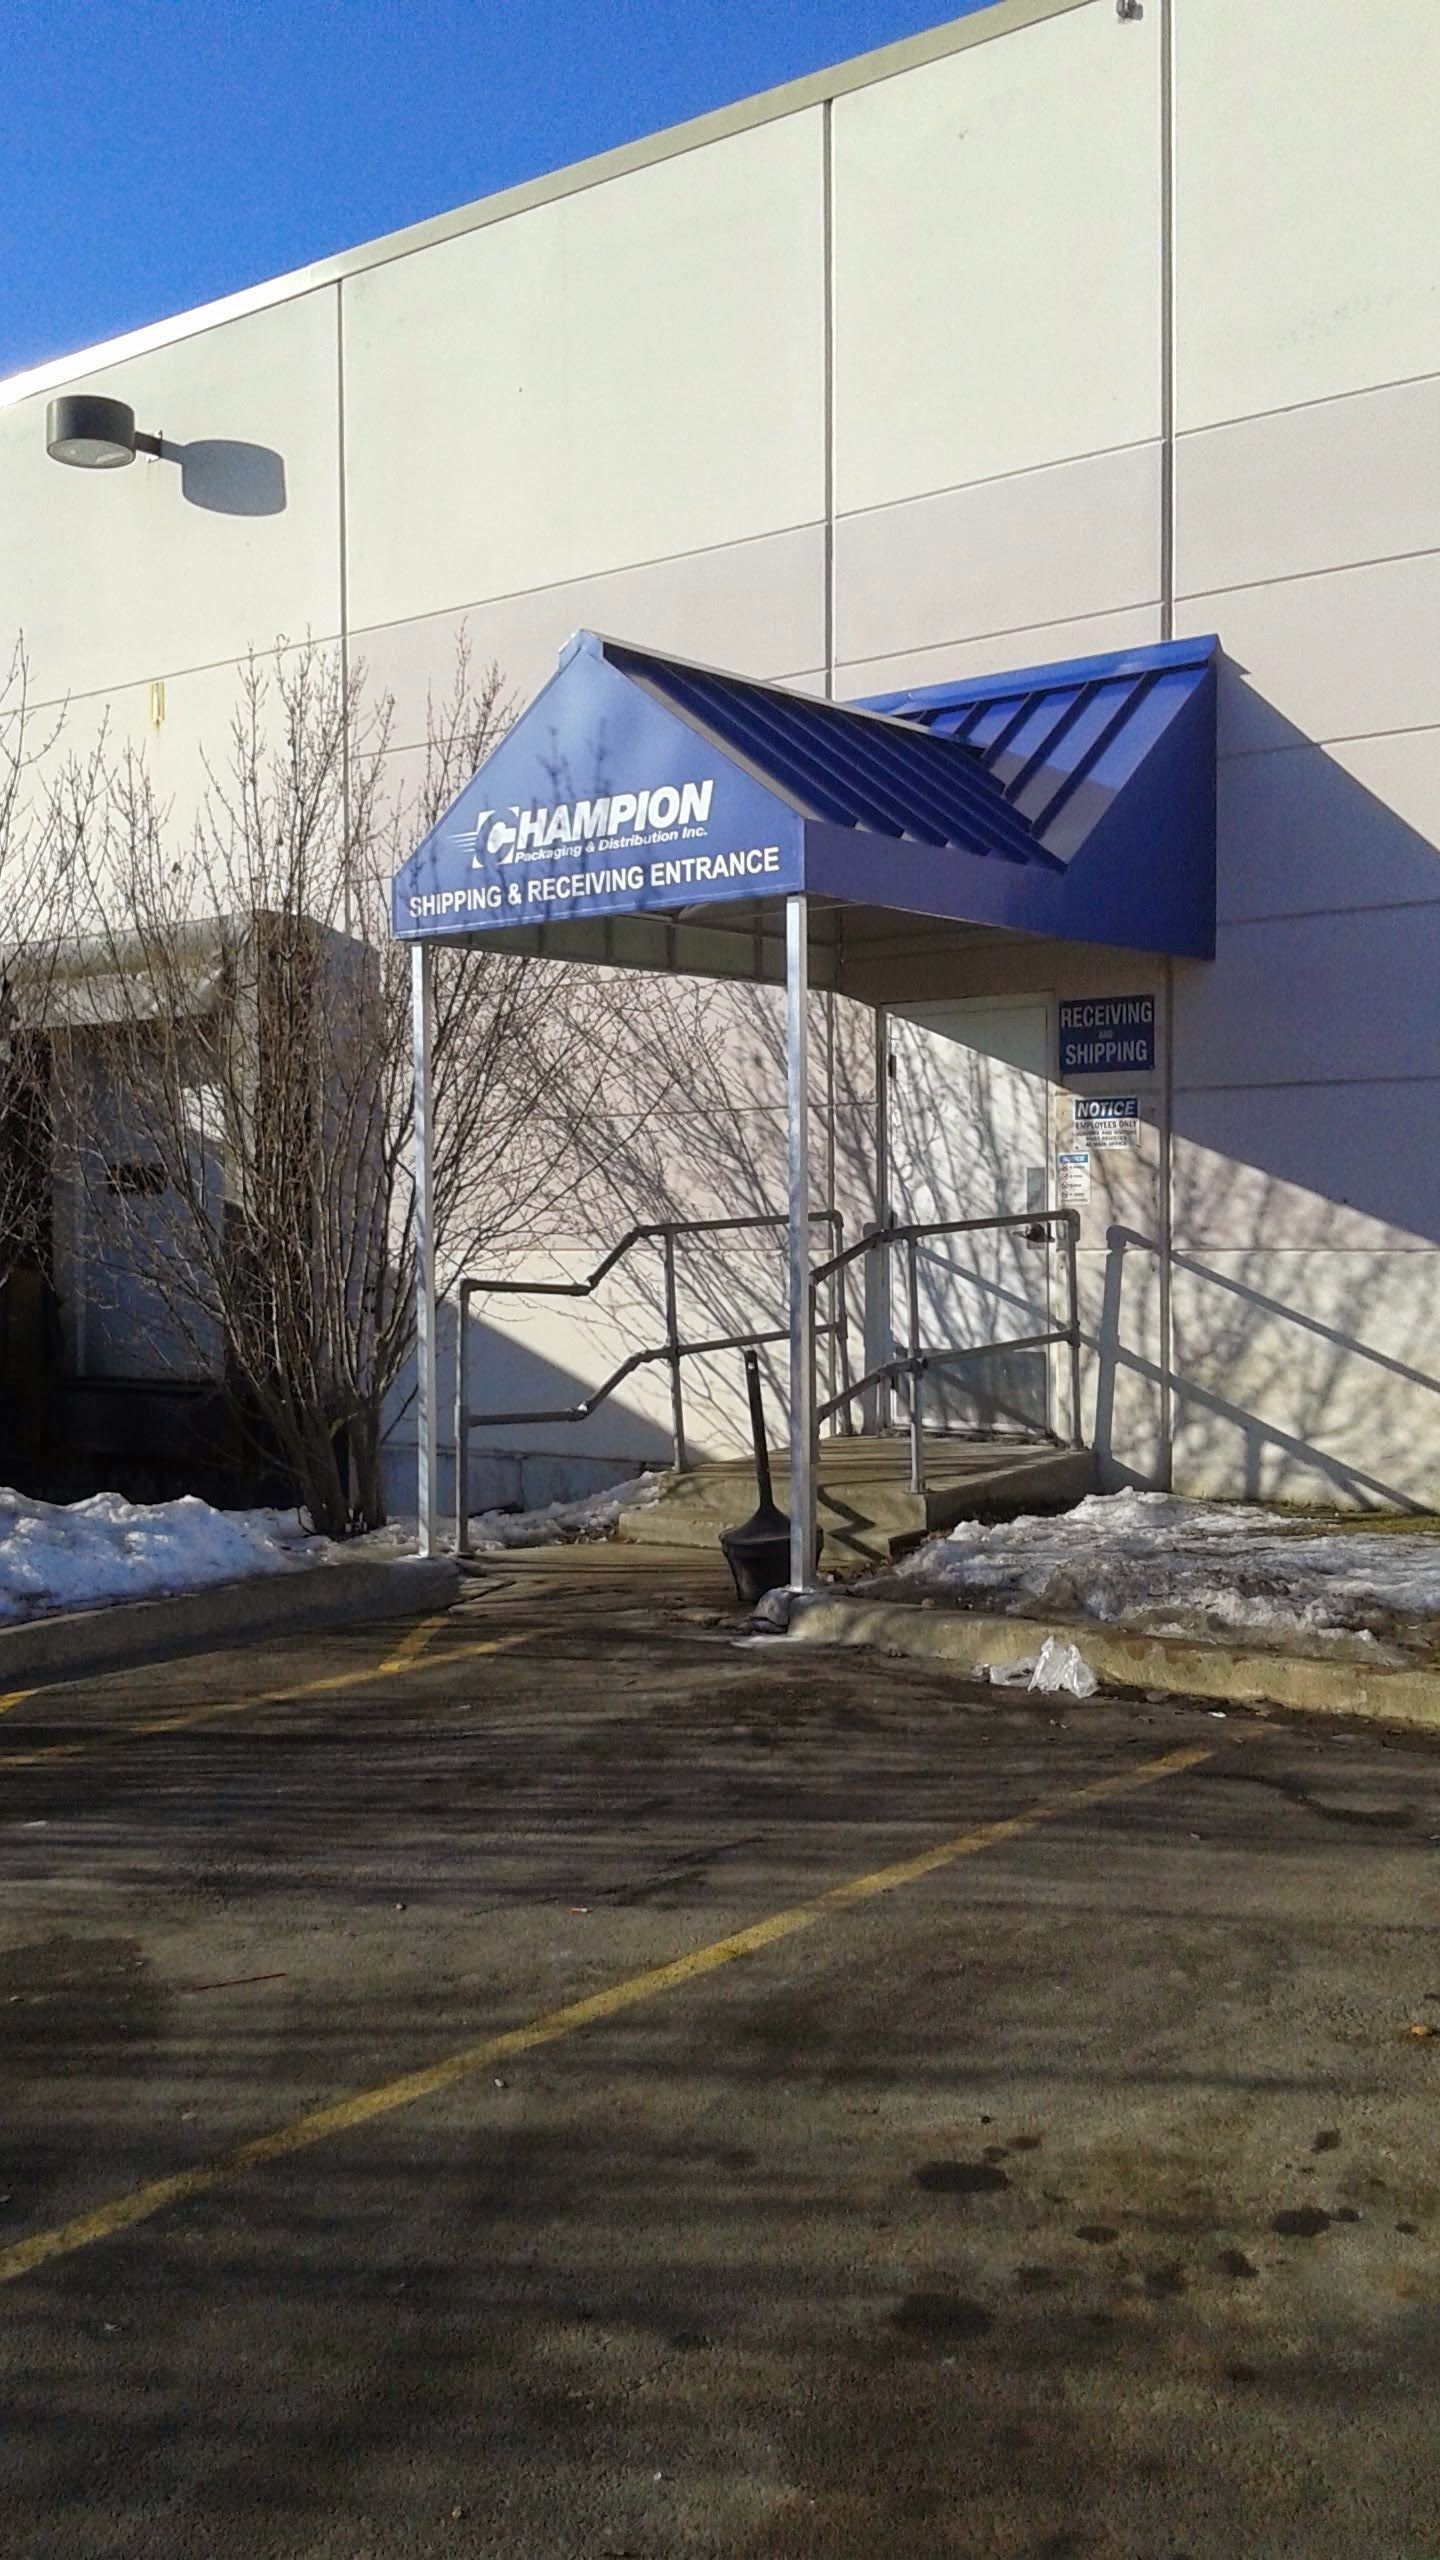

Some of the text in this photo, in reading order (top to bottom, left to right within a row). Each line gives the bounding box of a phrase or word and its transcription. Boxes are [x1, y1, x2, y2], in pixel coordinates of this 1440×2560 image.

[475, 780, 714, 865] CHAMPION
[514, 825, 708, 864] Packaging & Distribution Inc.
[409, 847, 780, 918] SHIPPING & RECEIVING ENTRANCE
[1061, 1002, 1152, 1028] RECEIVING
[1098, 1030, 1114, 1040] AND
[1065, 1040, 1148, 1065] SHIPPING
[1077, 1101, 1136, 1117] NOTICE
[1076, 1120, 1137, 1129] EMPLOYEES ONLY
